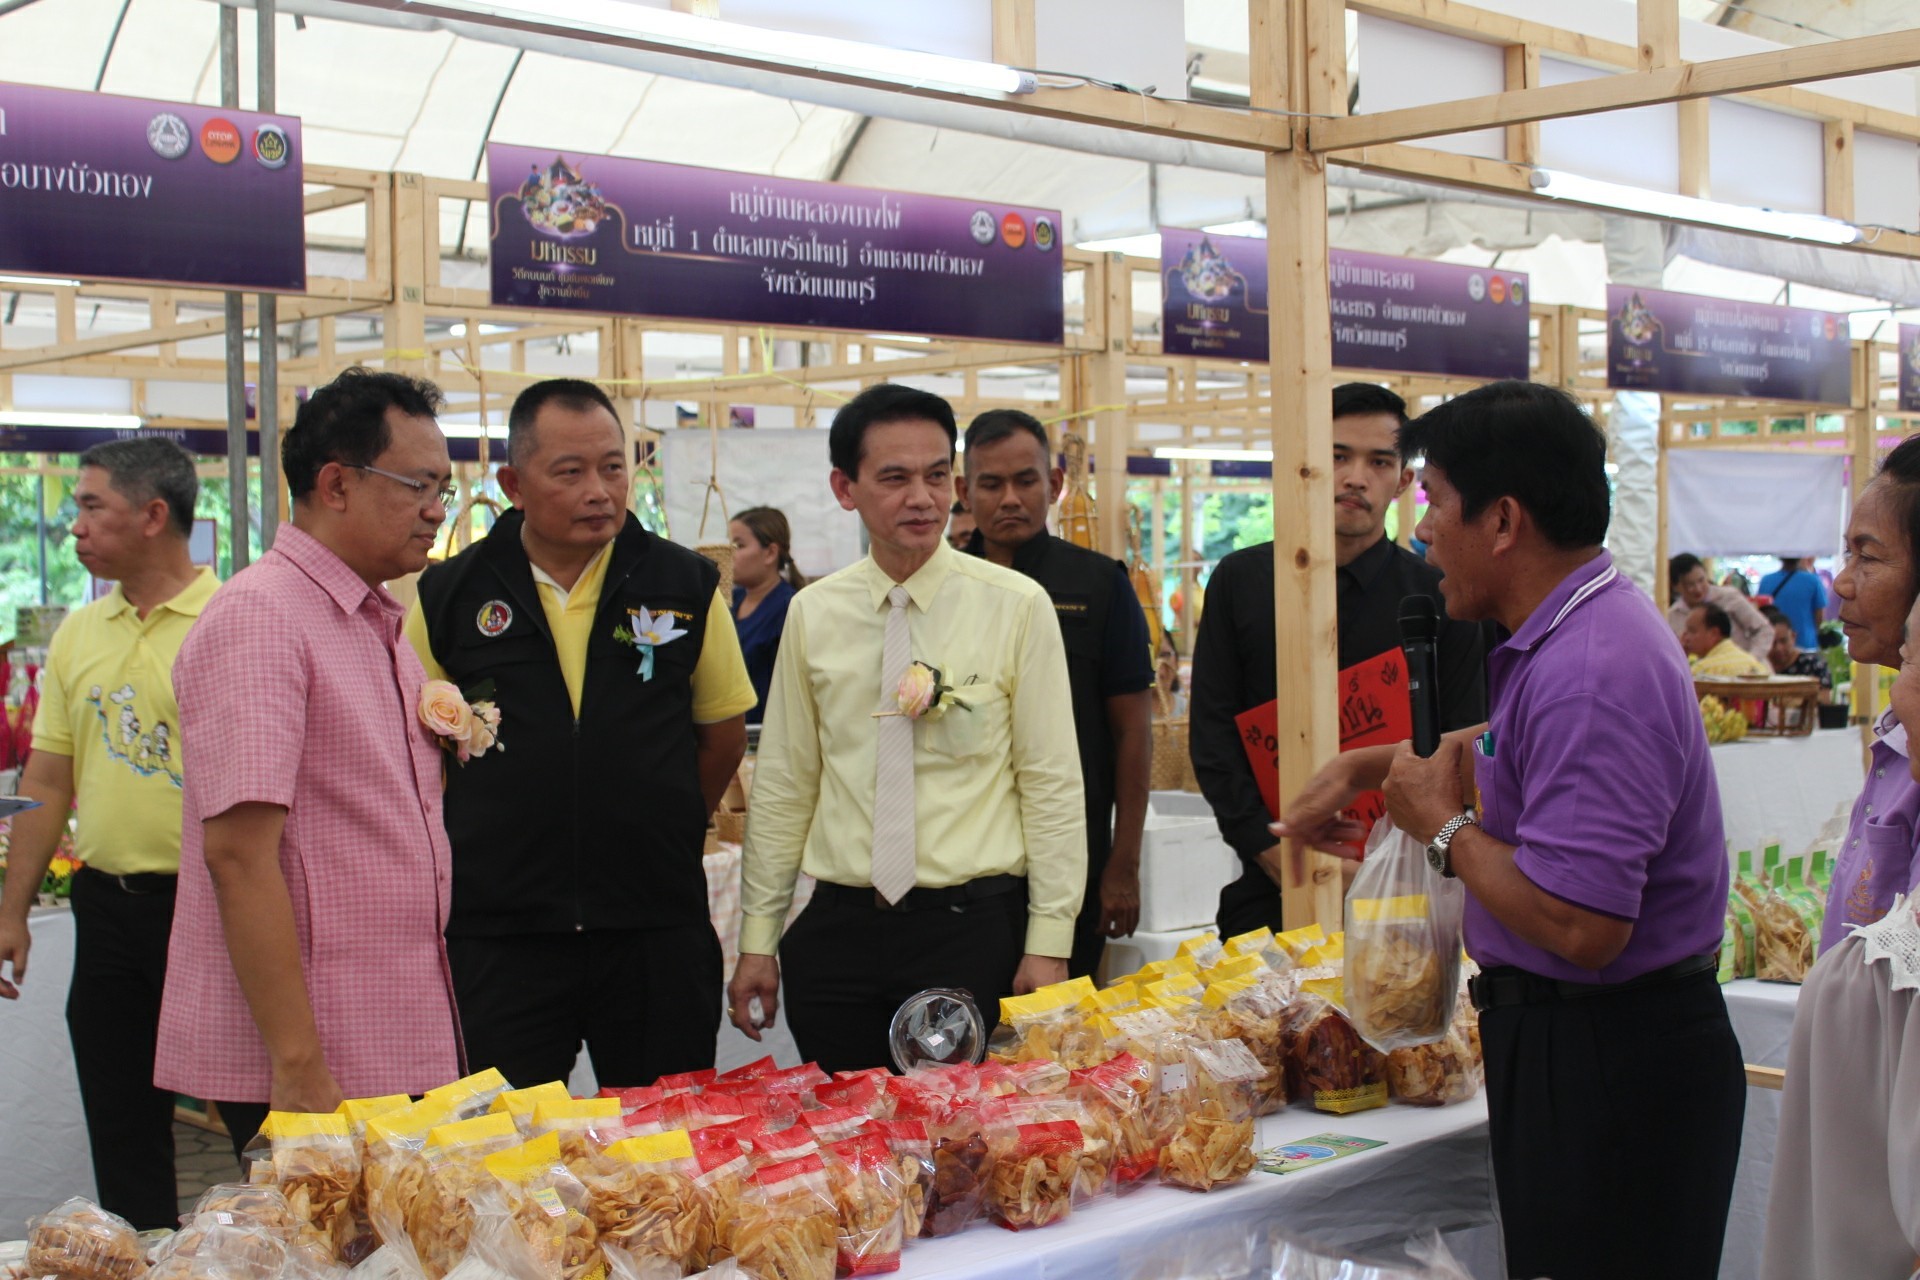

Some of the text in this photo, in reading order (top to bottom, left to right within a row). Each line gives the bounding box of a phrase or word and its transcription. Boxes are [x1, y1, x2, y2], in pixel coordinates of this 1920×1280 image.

[530, 240, 597, 265] มหกรรม
[634, 215, 984, 276] หมู่ที่ 1 ตำบลบางรักใหญ่ อำเภอบางบัวทอง
[761, 266, 876, 305] จังหวัดนนทบุรี
